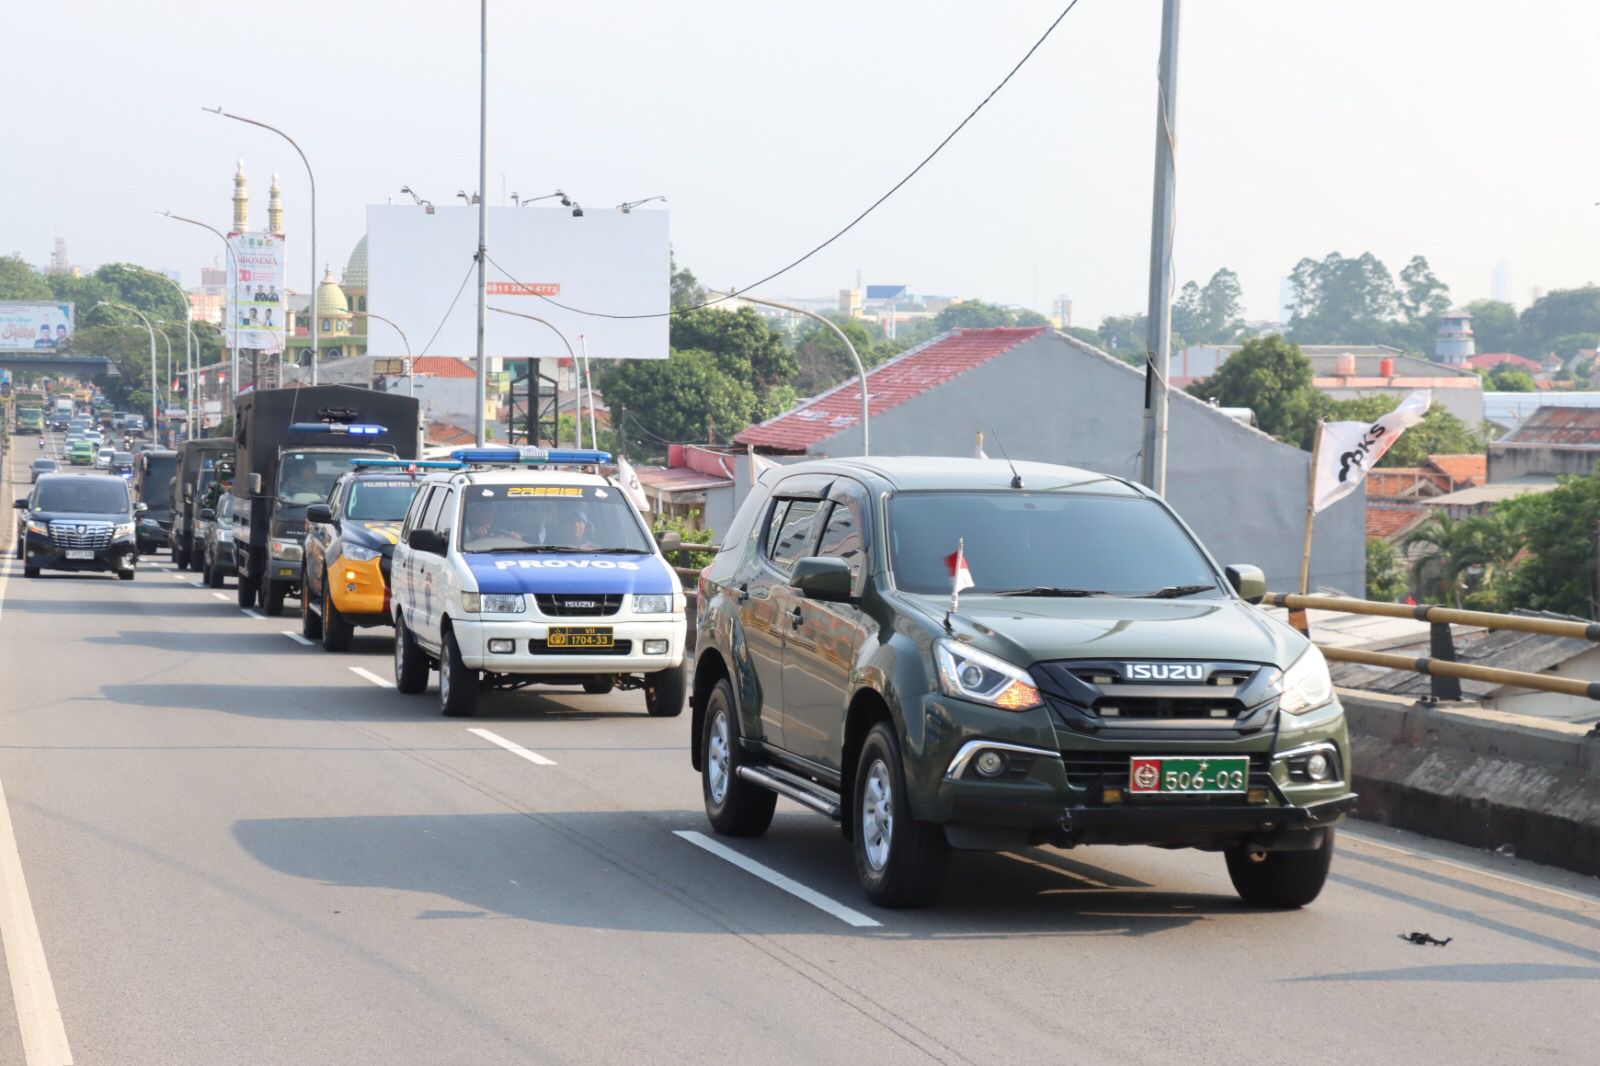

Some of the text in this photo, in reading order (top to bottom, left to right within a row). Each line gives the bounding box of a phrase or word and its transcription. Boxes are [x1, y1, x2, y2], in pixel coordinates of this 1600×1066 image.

[1351, 423, 1387, 467] PKS
[494, 559, 641, 570] PROVOS
[572, 635, 608, 645] 1704-33
[1126, 664, 1203, 680] ISUZU
[1165, 770, 1244, 791] 506-03
